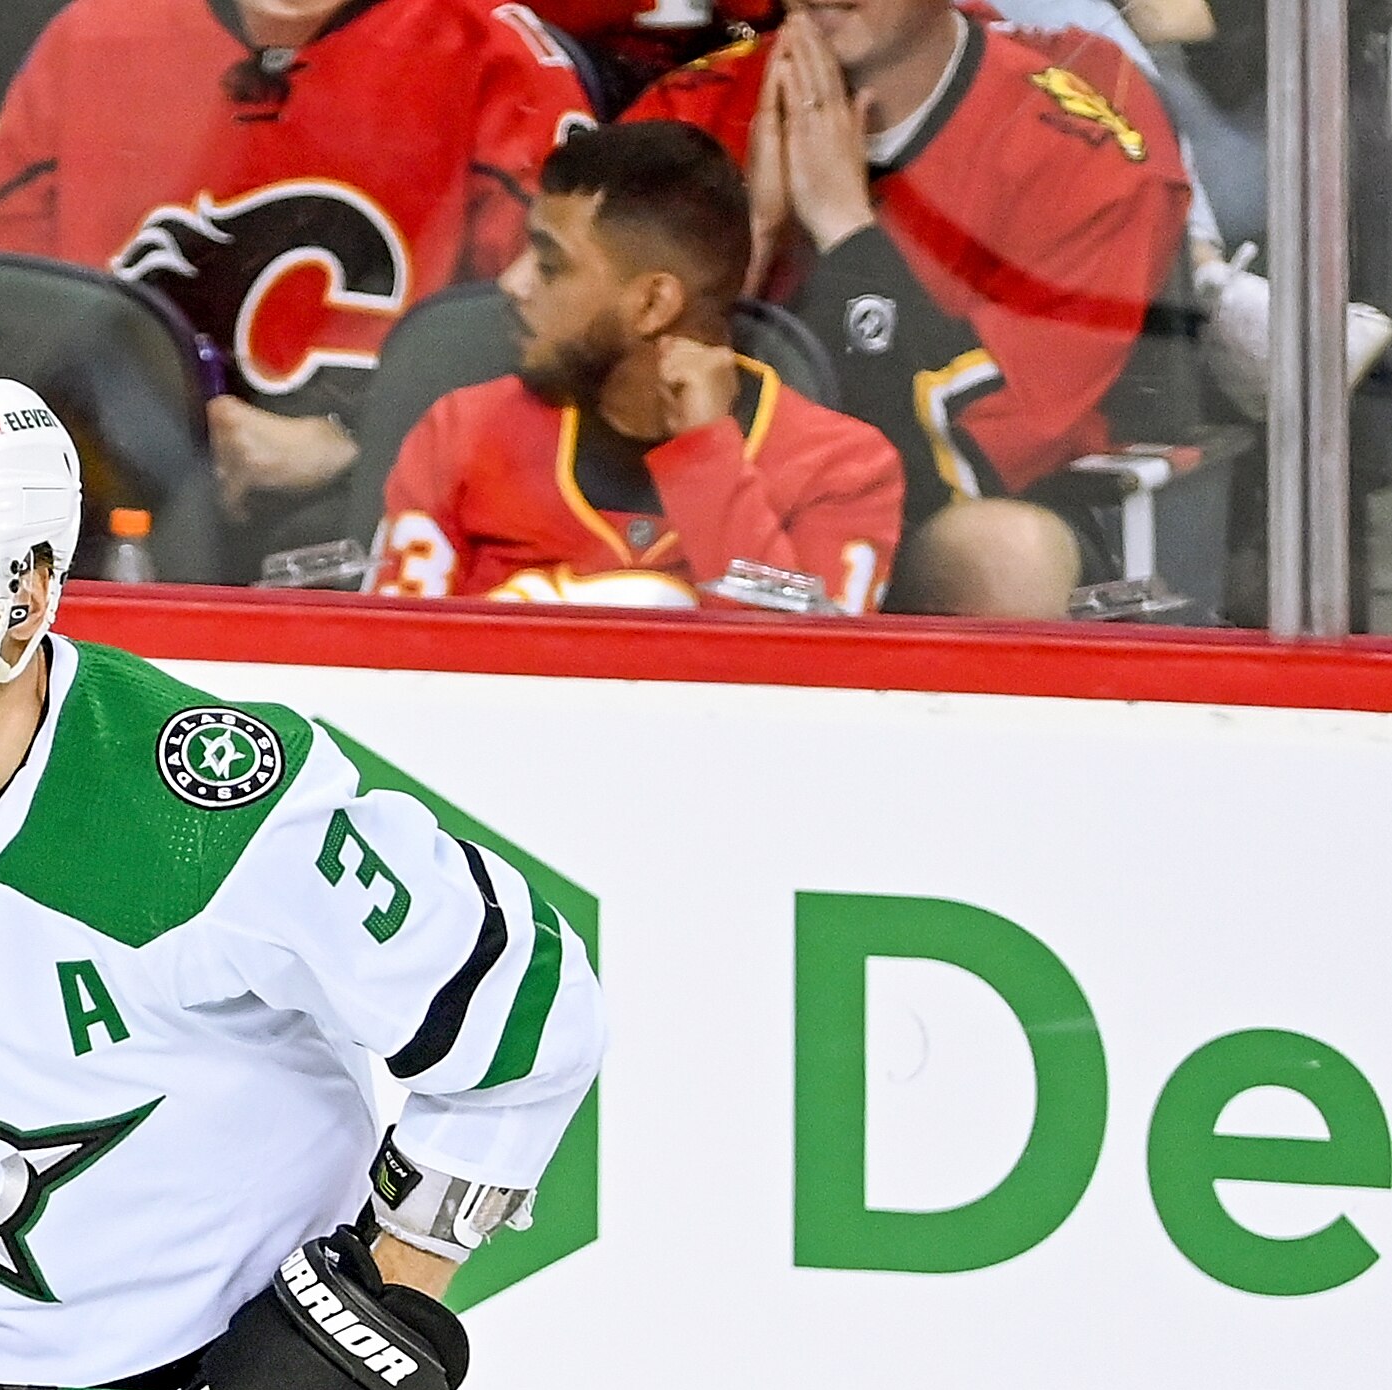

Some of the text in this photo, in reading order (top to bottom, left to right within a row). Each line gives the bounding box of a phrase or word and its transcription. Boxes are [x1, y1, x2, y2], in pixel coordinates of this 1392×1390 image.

[167, 713, 237, 789] DALLAS
[217, 736, 276, 800] STARS
[315, 808, 412, 945] 3
[55, 958, 131, 1058] A
[793, 889, 1392, 1298] De
[385, 1150, 408, 1178] CCM
